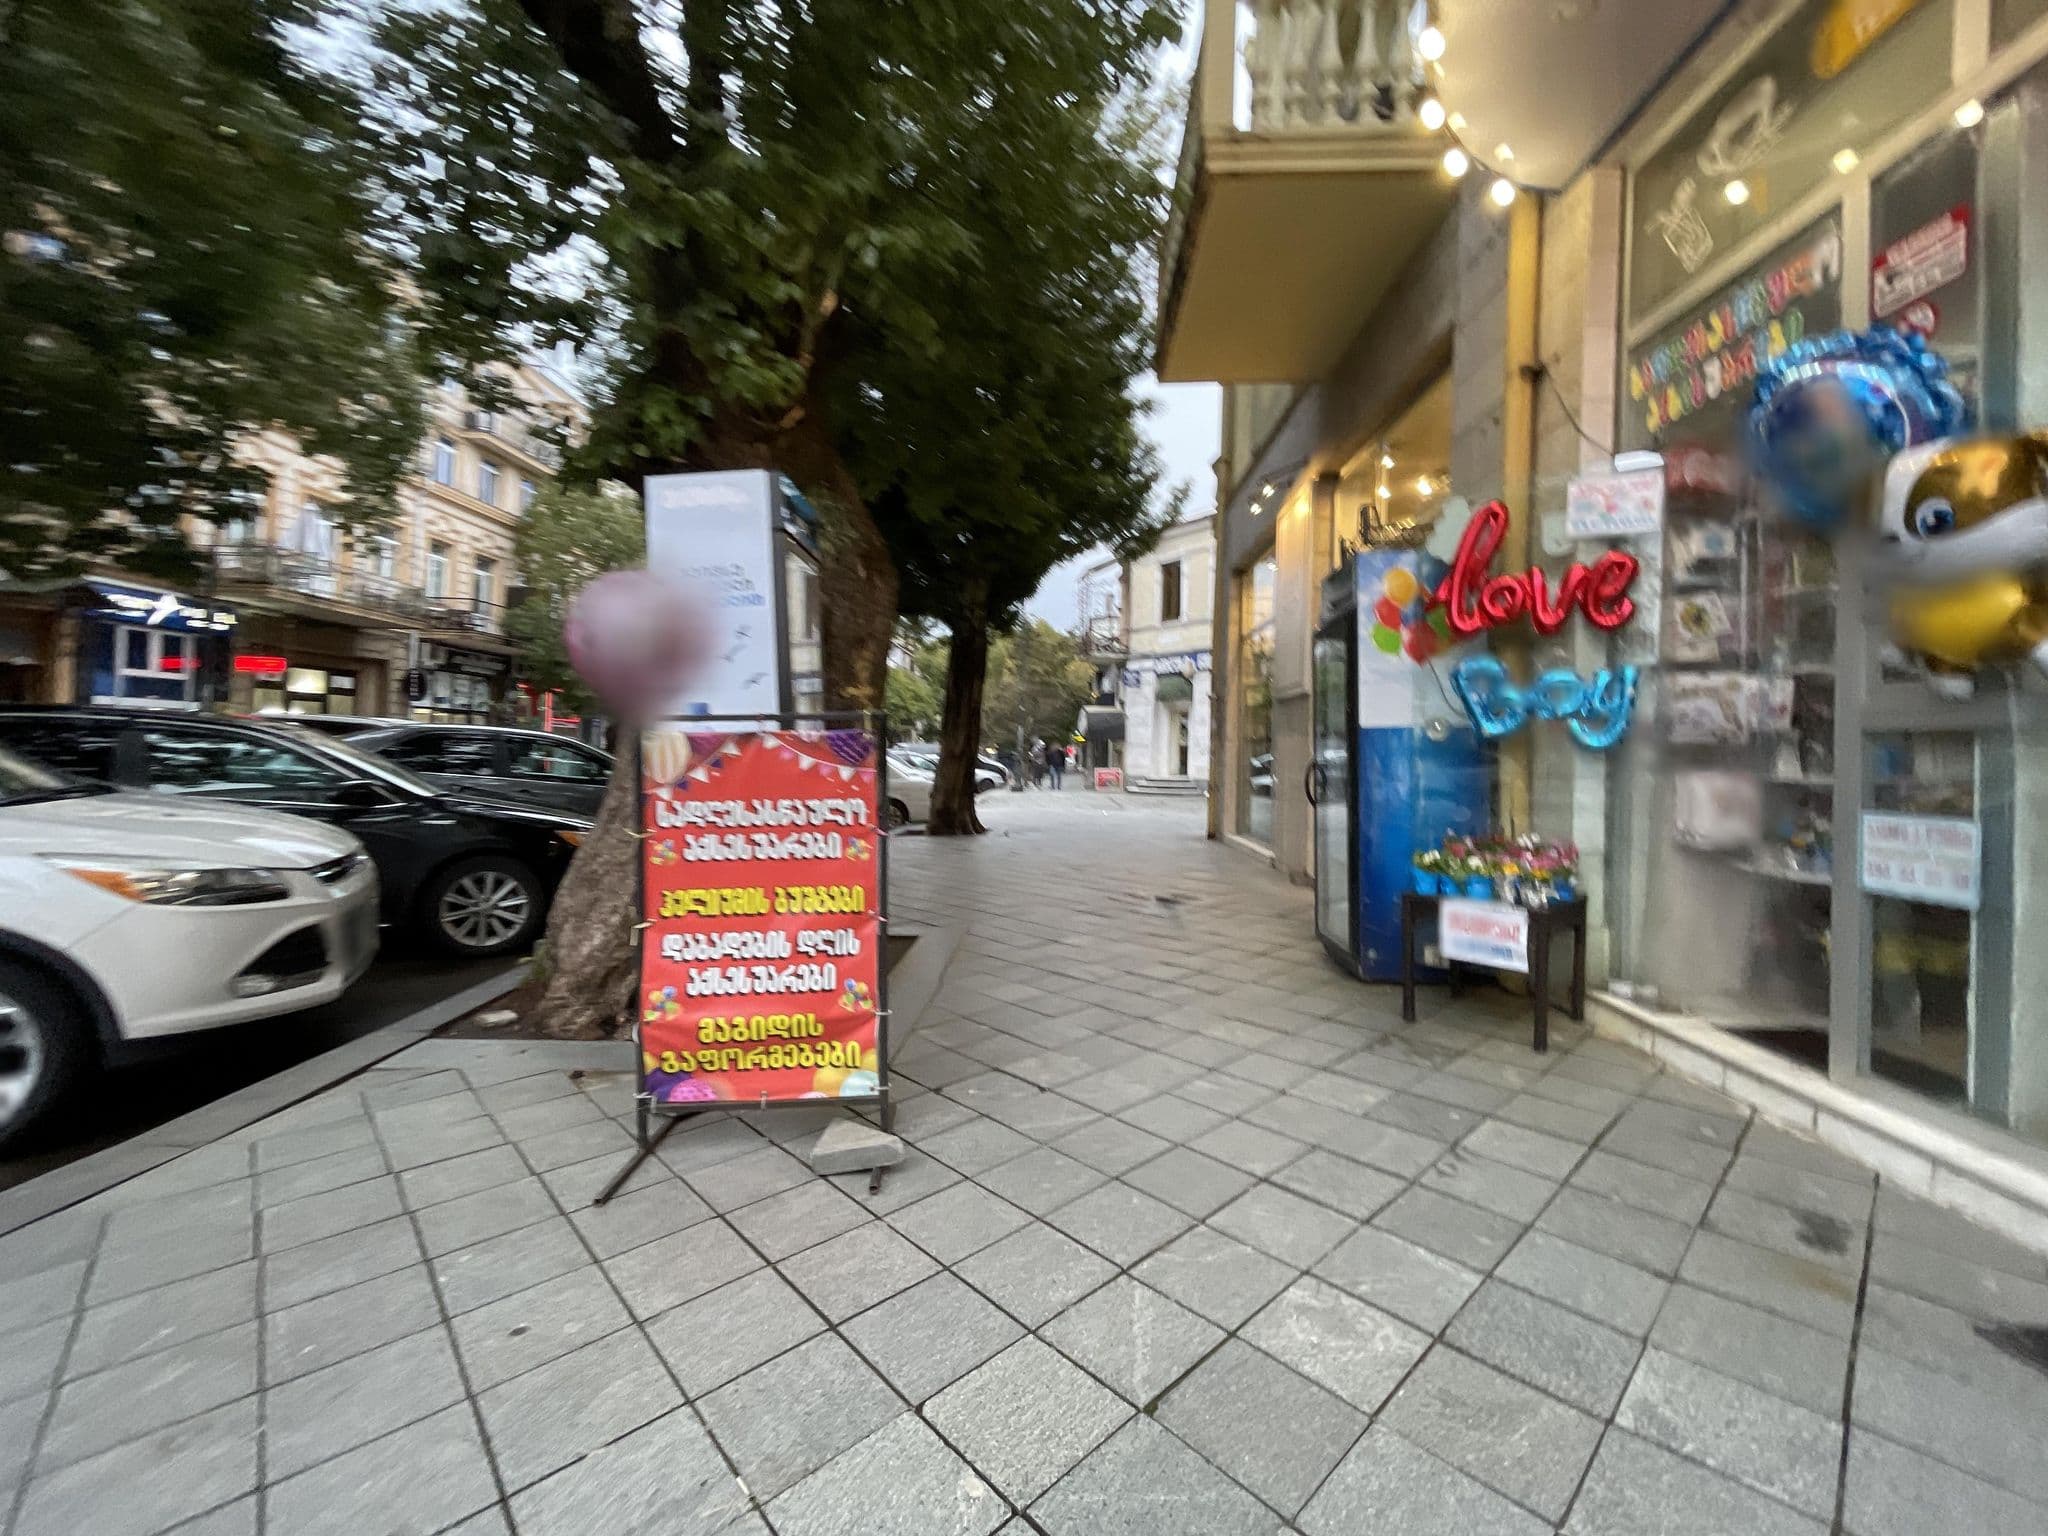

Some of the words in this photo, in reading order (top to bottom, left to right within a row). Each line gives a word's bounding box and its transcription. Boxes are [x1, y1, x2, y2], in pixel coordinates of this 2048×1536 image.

[682, 831, 842, 860] აქსესუარები
[659, 887, 770, 917] ჰელიუმის
[774, 884, 865, 914] ბუშტები
[661, 930, 792, 961] დაბადების
[796, 928, 861, 956] დღის
[686, 963, 837, 995] აქსესუარები
[698, 1012, 824, 1043] მაგიდის
[660, 1040, 862, 1074] გაფორმებები
